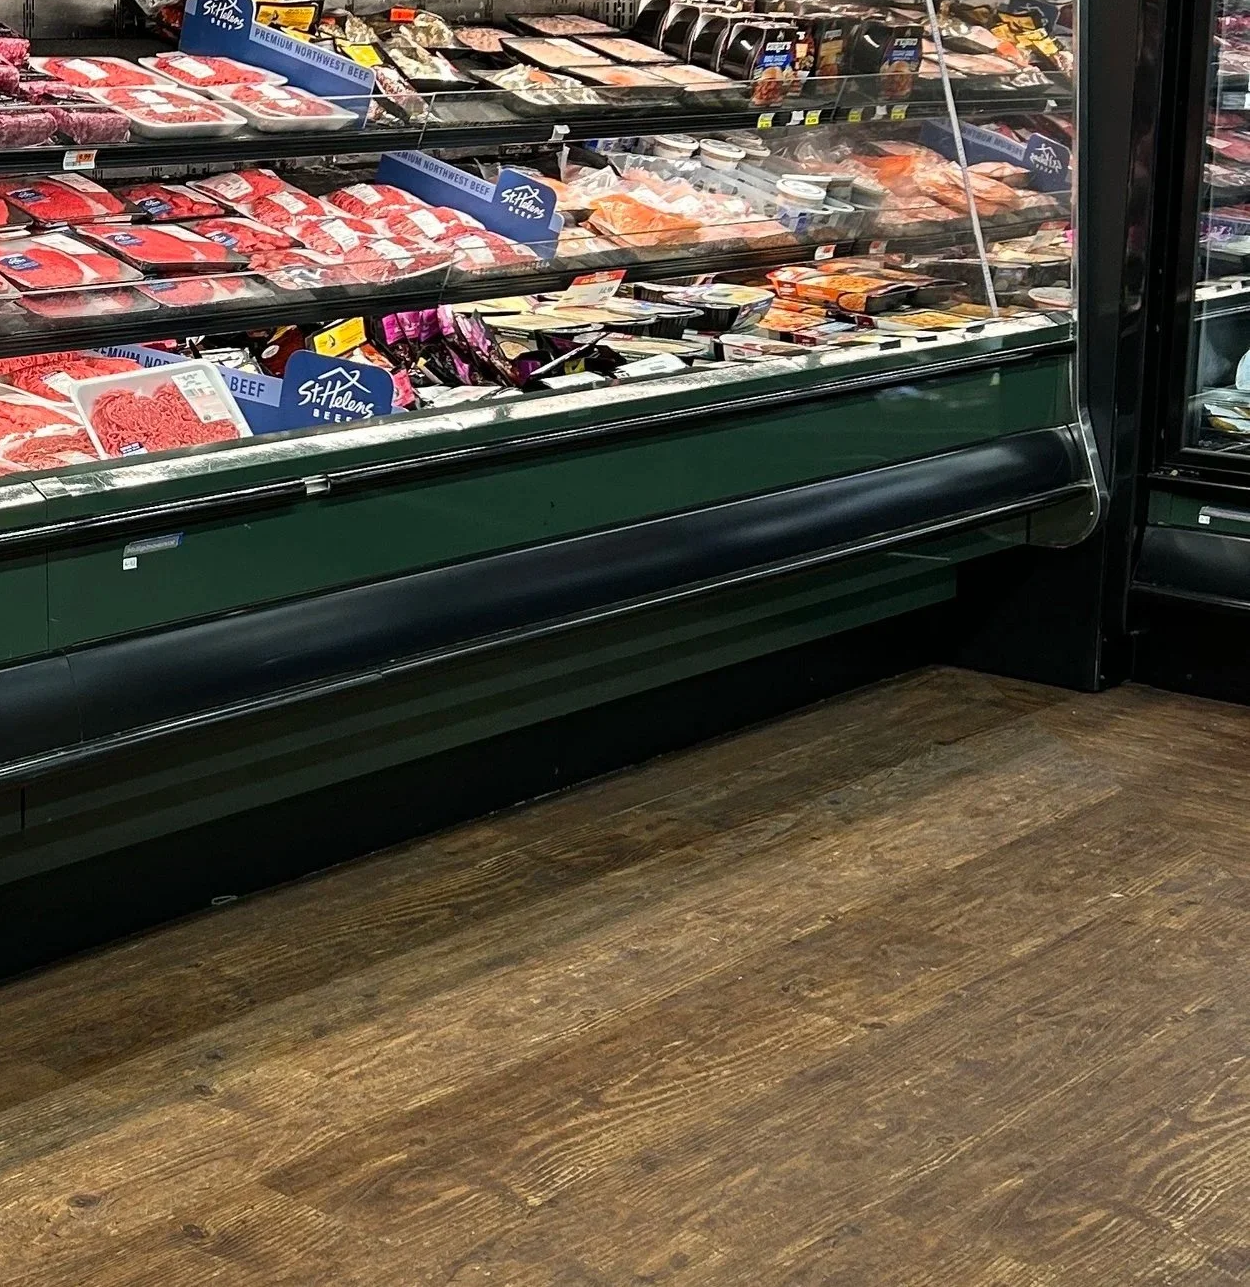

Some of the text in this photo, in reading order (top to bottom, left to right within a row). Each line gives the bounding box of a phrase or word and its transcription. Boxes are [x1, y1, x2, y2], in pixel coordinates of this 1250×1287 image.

[254, 29, 371, 82] PREMIUM NORTHWEST BEEF
[423, 158, 470, 187] NORTHWEST
[469, 180, 491, 197] BEEF
[230, 377, 266, 398] BEEF
